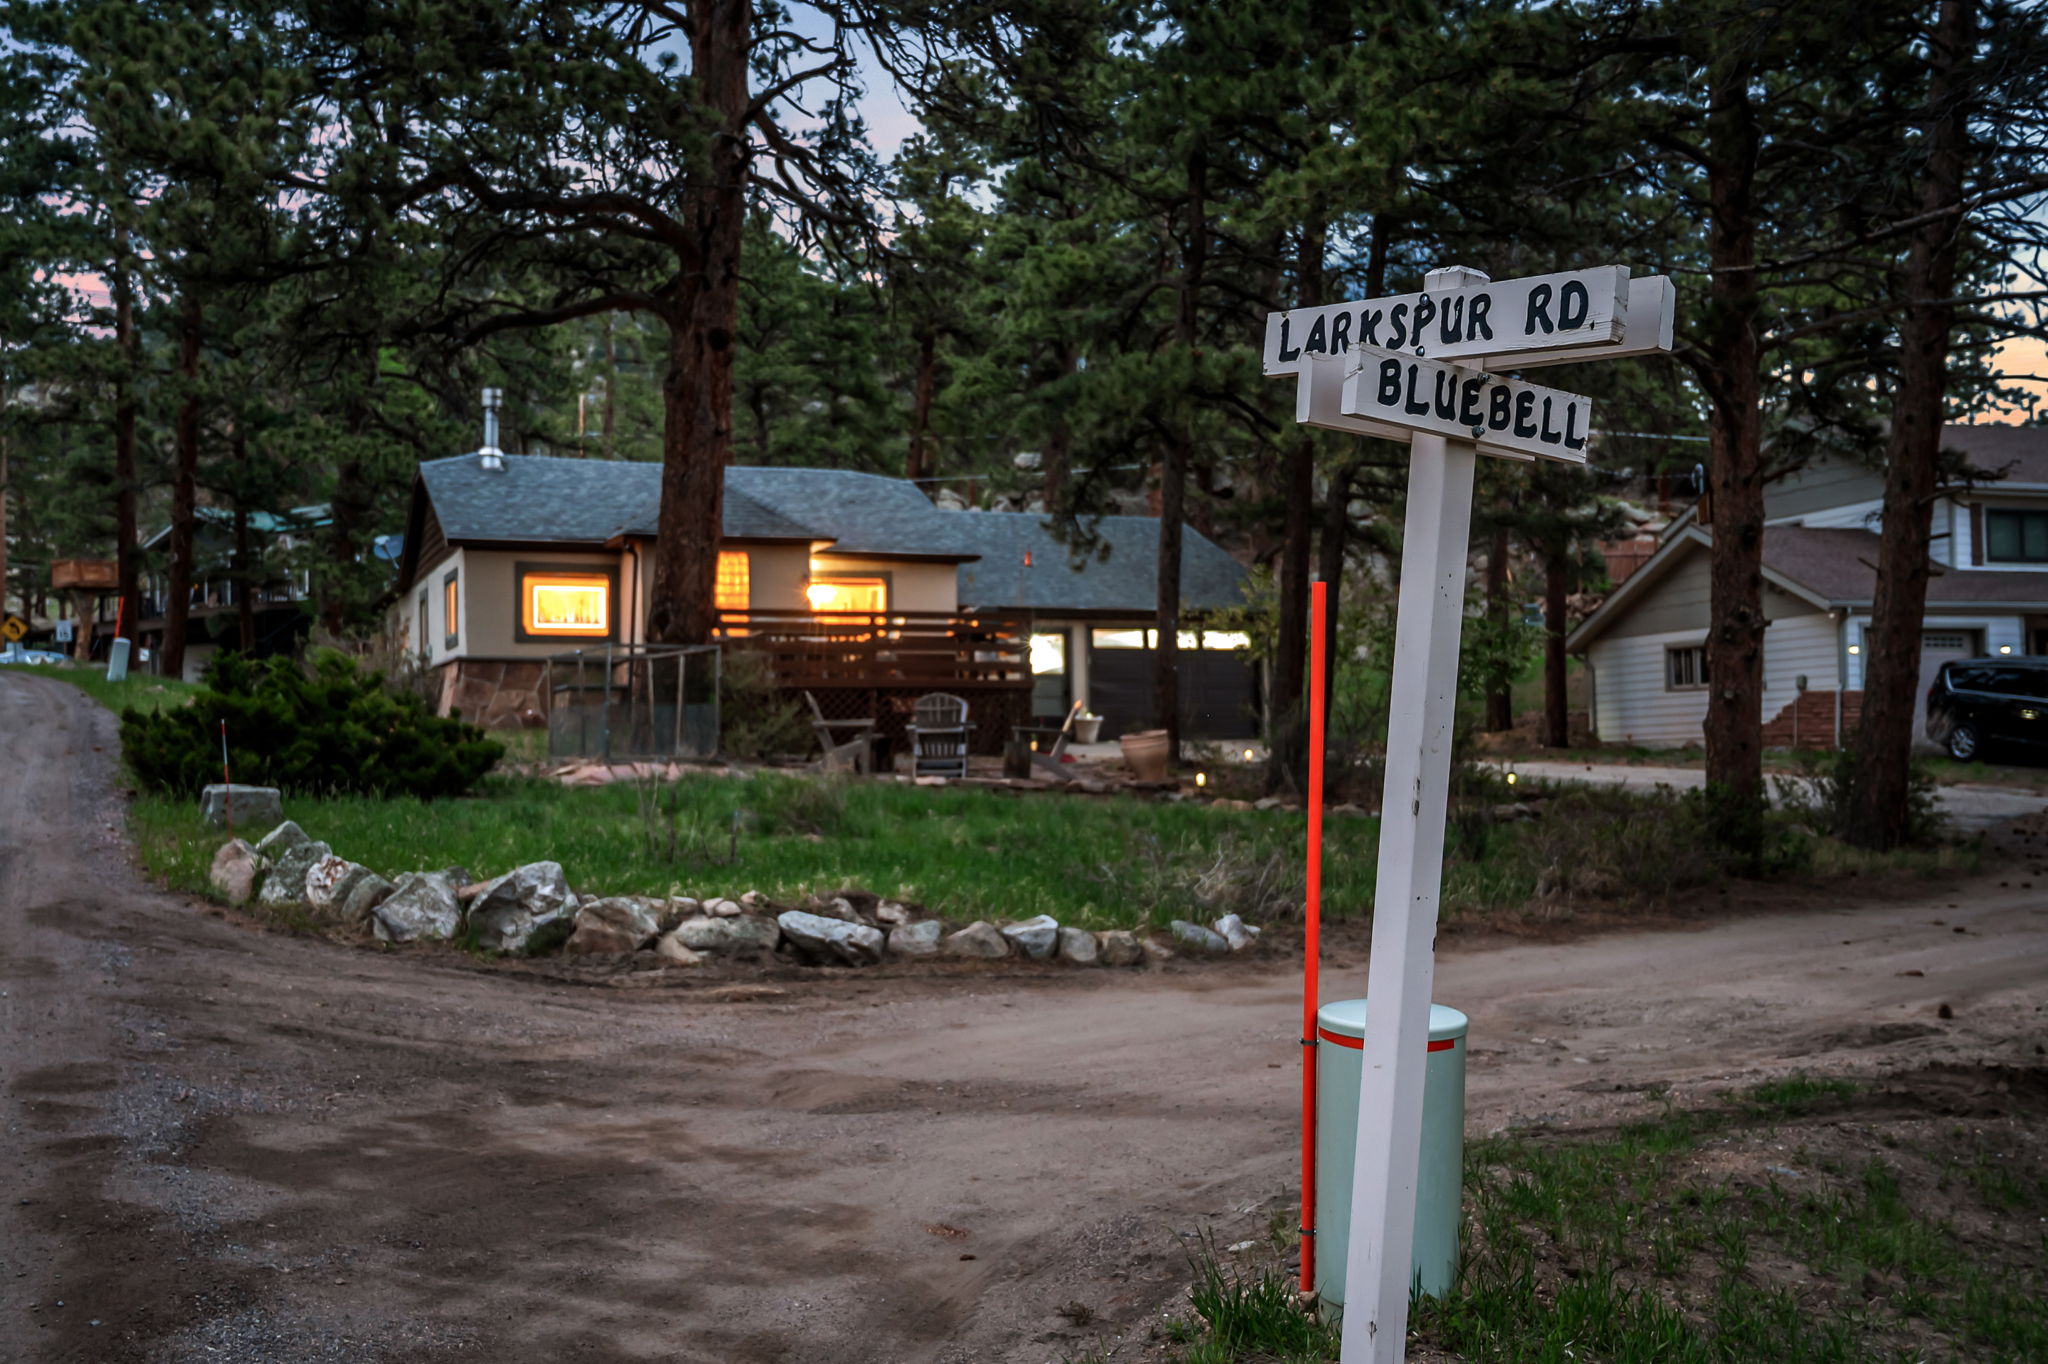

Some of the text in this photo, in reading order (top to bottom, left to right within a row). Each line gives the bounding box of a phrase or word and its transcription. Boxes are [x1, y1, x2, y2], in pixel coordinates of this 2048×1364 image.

[1279, 280, 1589, 362] LARKSPUR RD
[1377, 358, 1586, 450] BLUEBELL
